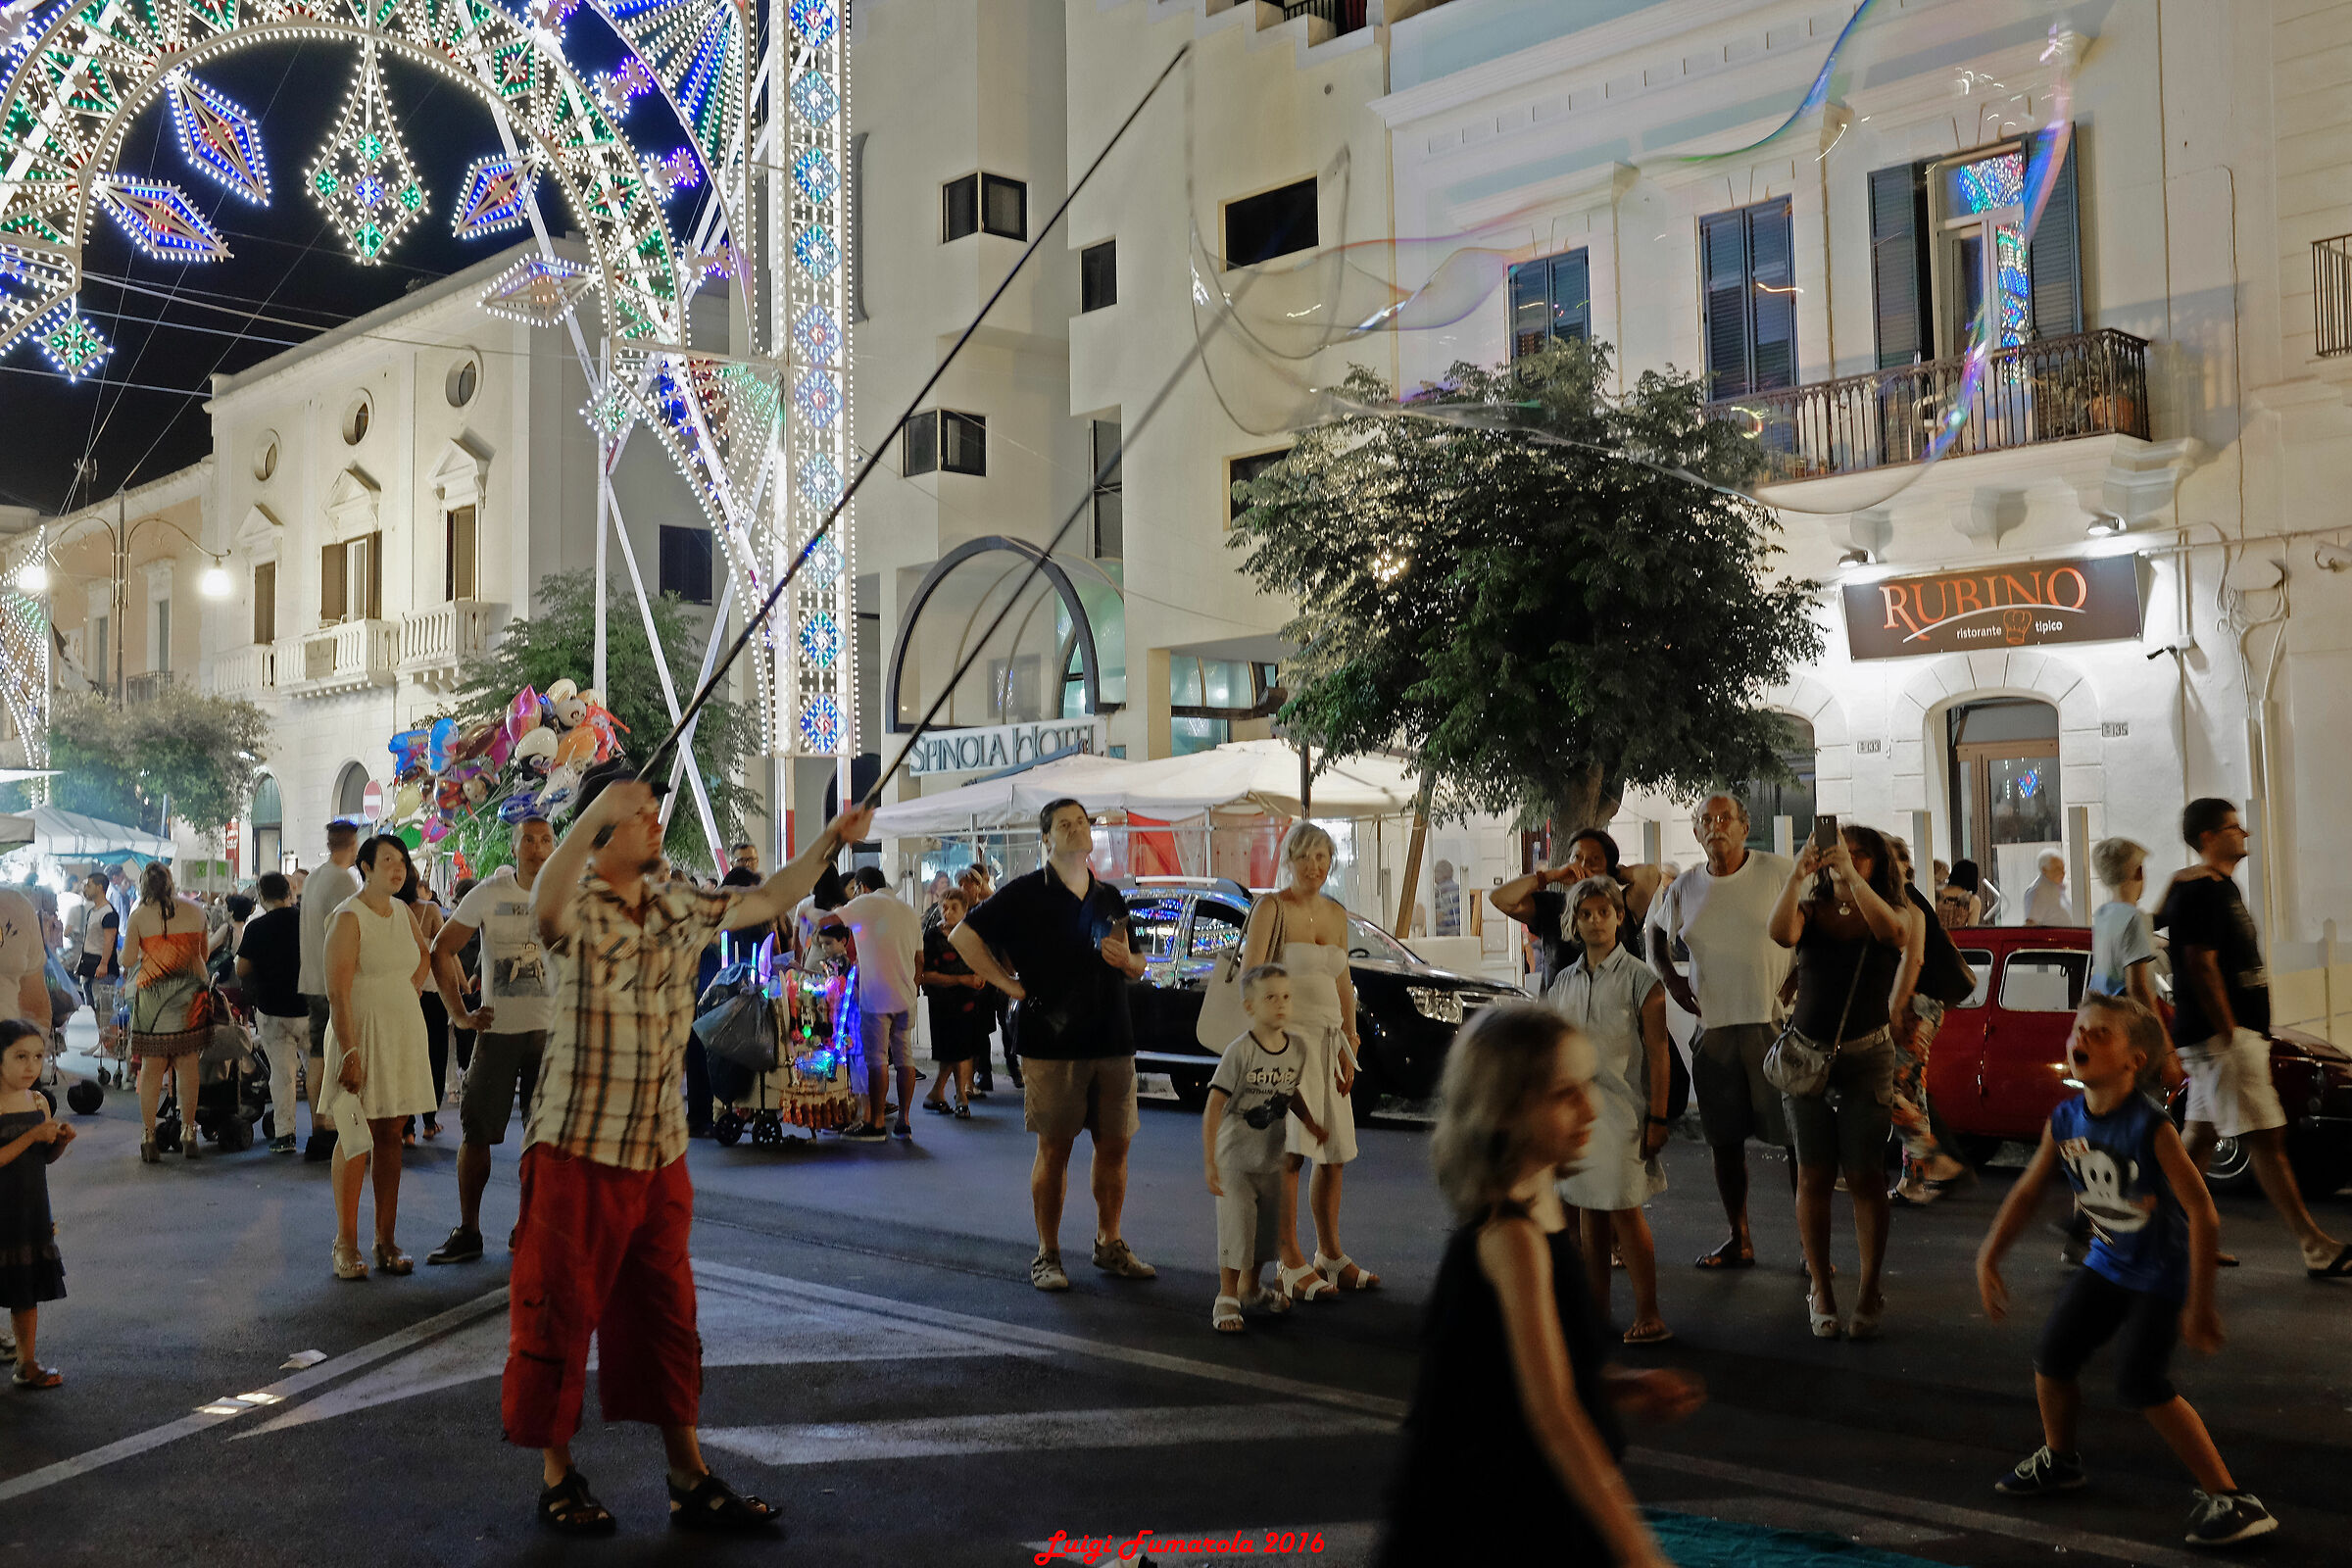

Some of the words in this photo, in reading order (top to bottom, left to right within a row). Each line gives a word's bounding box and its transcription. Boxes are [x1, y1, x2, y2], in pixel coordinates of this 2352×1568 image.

[1879, 566, 2087, 641] RUBINO
[1956, 624, 2002, 640] ristorante
[2034, 619, 2063, 635] tipico
